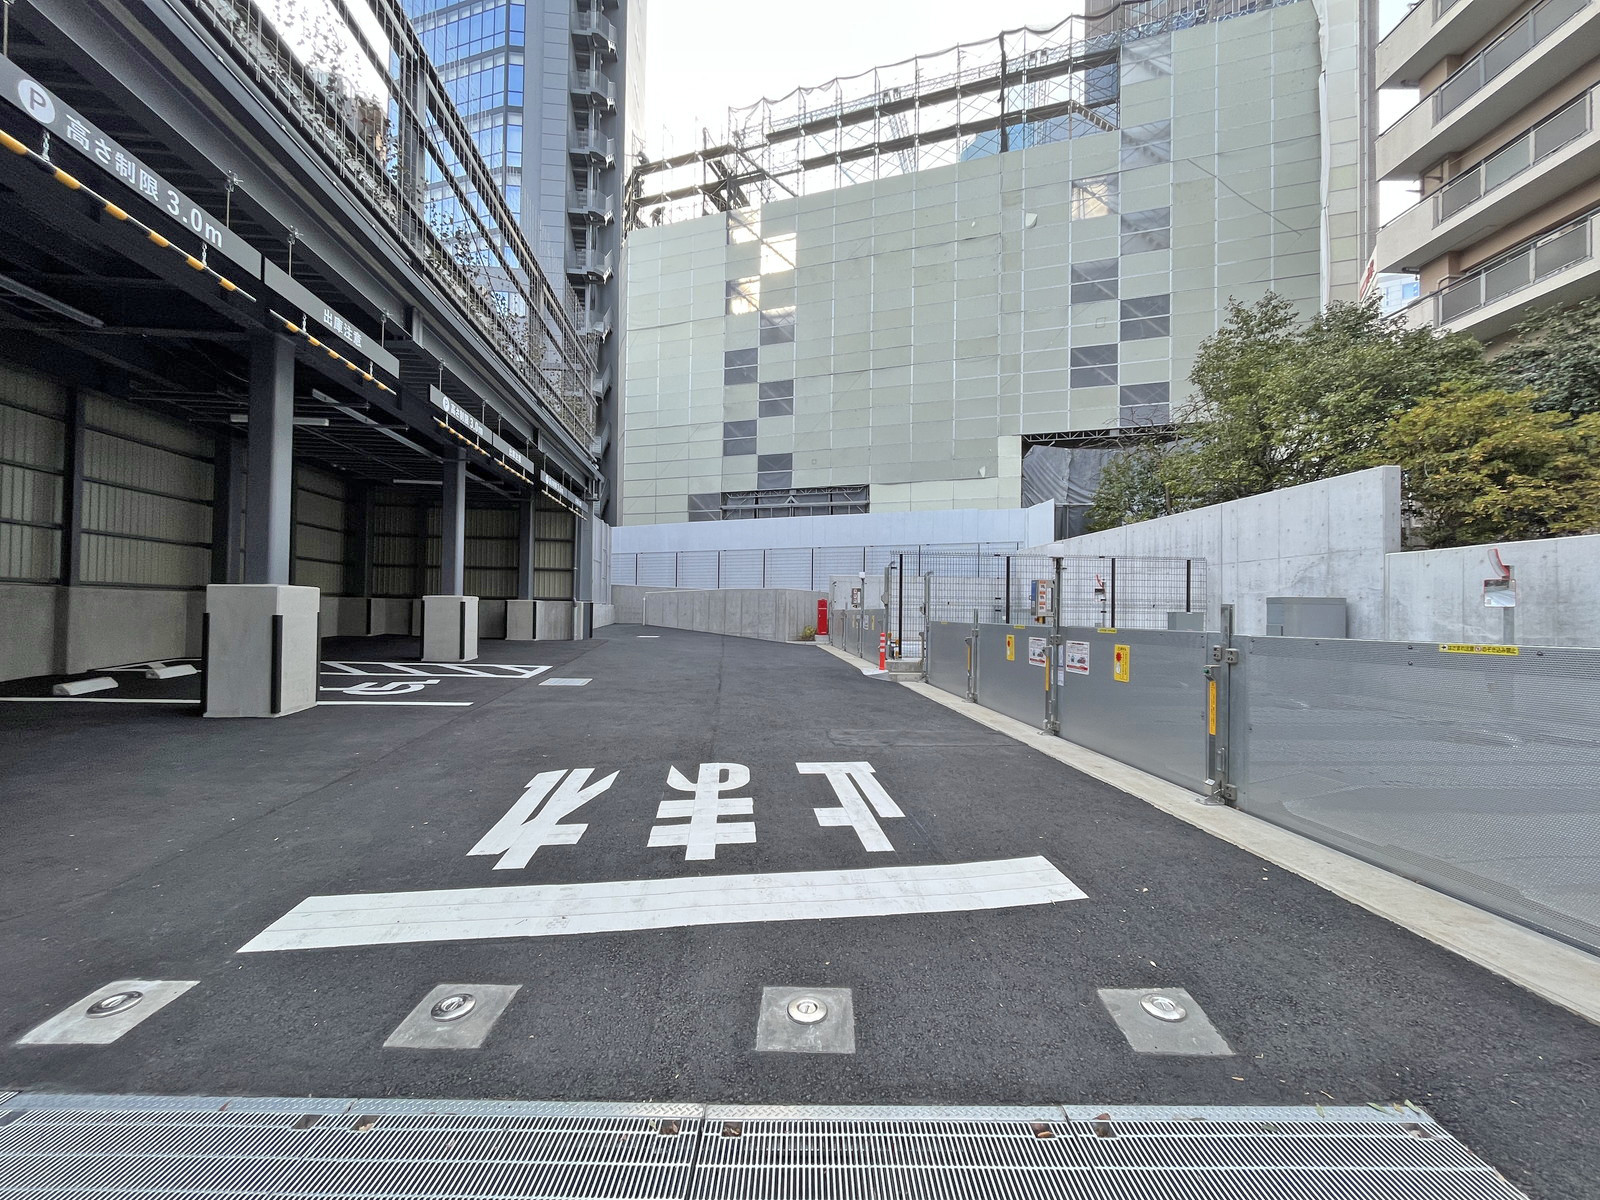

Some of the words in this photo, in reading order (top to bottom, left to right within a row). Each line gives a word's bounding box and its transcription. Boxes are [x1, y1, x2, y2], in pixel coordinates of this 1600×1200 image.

[29, 86, 47, 111] P
[65, 113, 159, 202] 高さ制限
[166, 190, 222, 249] 3.0m
[323, 308, 362, 348] 出庫注意
[466, 761, 906, 870] 止まれ
